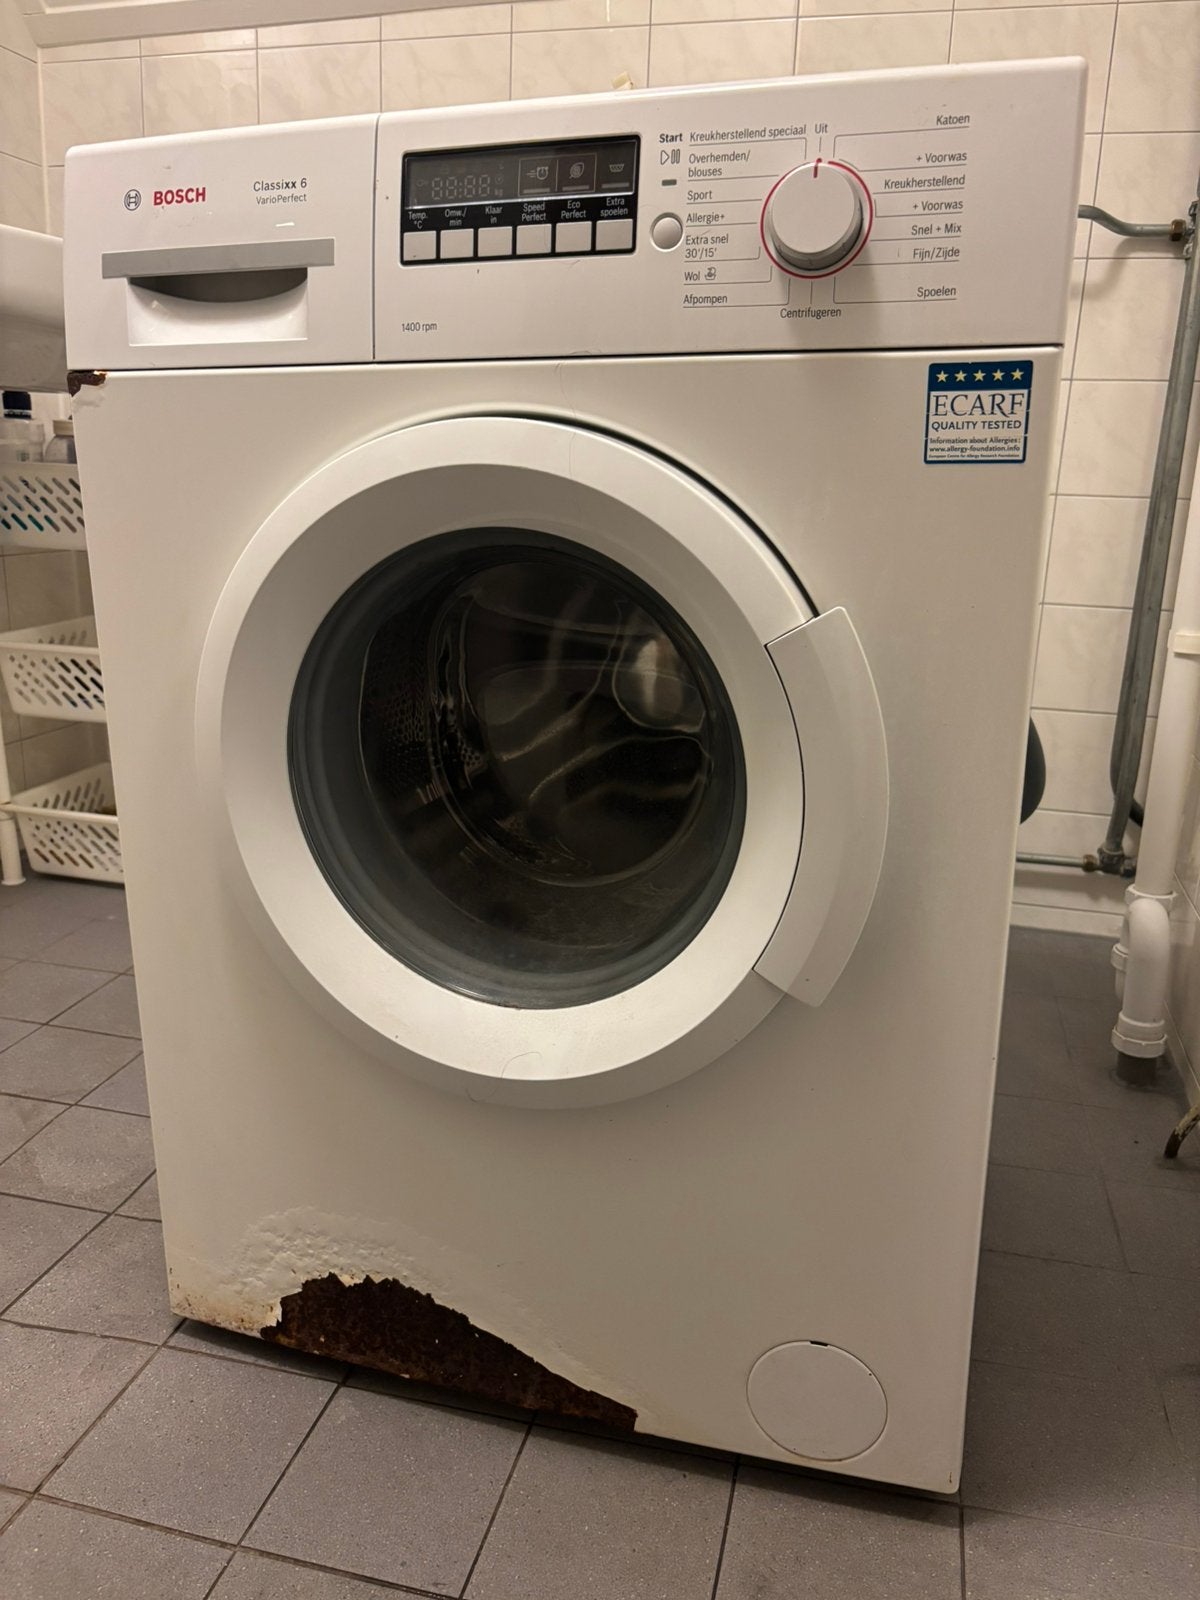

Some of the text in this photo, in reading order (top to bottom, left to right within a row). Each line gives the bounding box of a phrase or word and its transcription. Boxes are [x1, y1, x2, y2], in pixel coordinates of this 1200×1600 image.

[936, 114, 970, 126] Katoen
[689, 124, 806, 142] Kreukherstellend speciaal
[815, 124, 828, 134] Uit
[659, 132, 683, 143] Start
[689, 150, 751, 164] Overhemden/
[925, 152, 967, 163] Voorwas
[688, 167, 722, 178] blouses
[253, 178, 307, 192] Classixx 6
[884, 174, 966, 189] Kreukherstellend
[153, 187, 206, 206] BOSCH
[256, 193, 307, 205] VarioPerfect
[606, 197, 625, 206] Extra
[687, 190, 712, 202] Sport
[485, 205, 502, 215] Klaar
[523, 203, 545, 214] Speed
[567, 200, 580, 210] Eco
[921, 201, 963, 211] Voorwas
[408, 210, 427, 222] Temp.
[444, 207, 467, 218] Omw./
[521, 212, 547, 222] Perfect
[561, 209, 586, 219] Perfect
[600, 206, 628, 217] spoelen
[449, 218, 462, 226] min
[490, 216, 497, 224] in
[686, 212, 725, 225] Allergie+
[911, 224, 933, 236] Snel
[944, 223, 961, 233] Mix
[686, 234, 729, 246] Extra snel
[913, 247, 960, 260] Fijn/Zijde
[684, 271, 700, 281] Wol
[917, 286, 956, 299] Spoelen
[683, 294, 728, 306] Afpompen
[780, 307, 841, 319] Centrifugeren
[401, 321, 438, 333] 1400 rpm
[932, 393, 1025, 418] ECARF
[931, 420, 1022, 432] QUALITY TESTED
[929, 436, 968, 444] Information
[970, 436, 987, 444] about
[929, 444, 1020, 453] www.allergy-foundation.info
